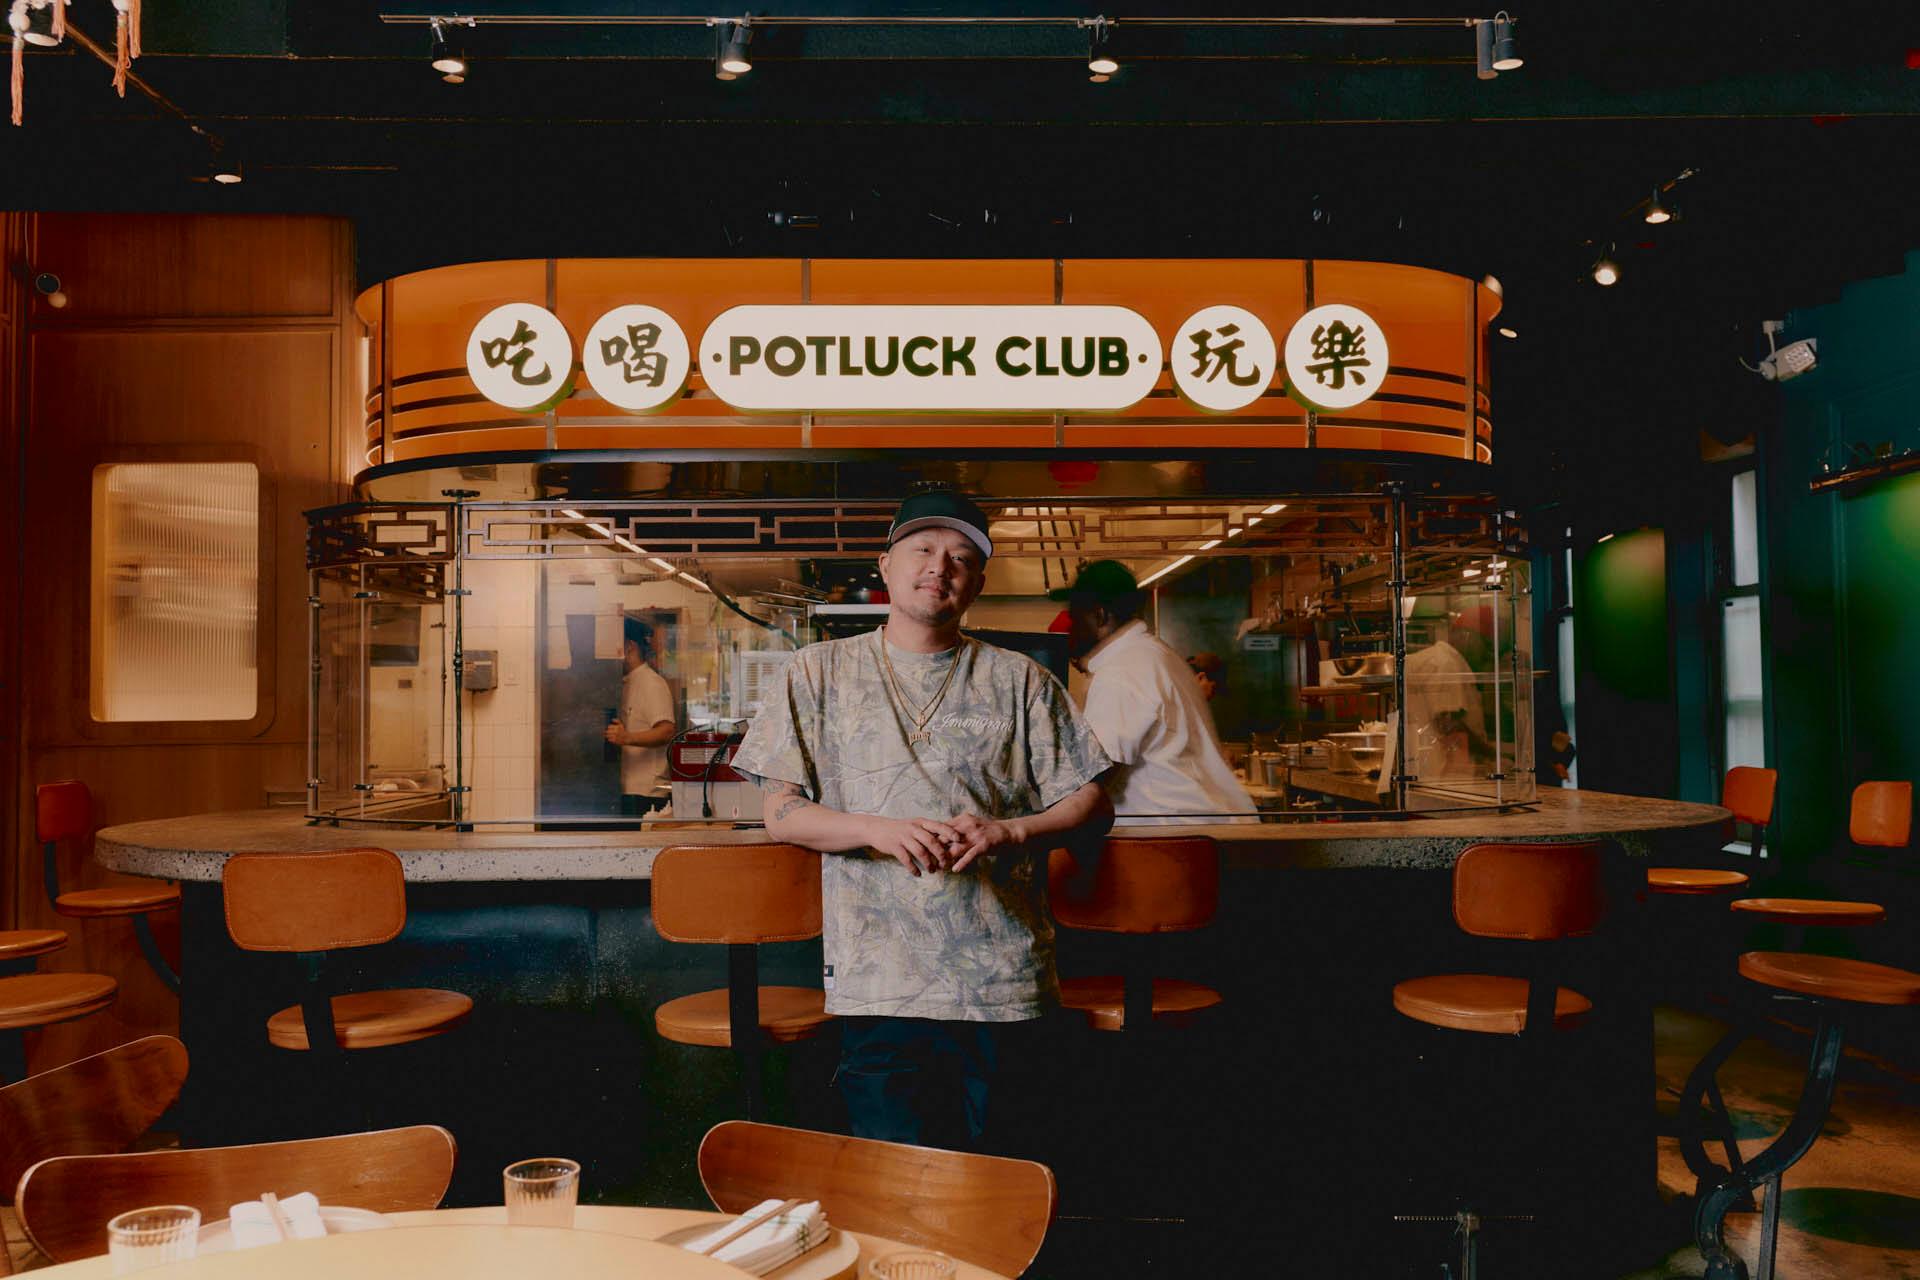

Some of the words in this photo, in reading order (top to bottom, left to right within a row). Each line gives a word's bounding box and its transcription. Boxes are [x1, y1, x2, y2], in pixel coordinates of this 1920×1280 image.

[480, 320, 668, 387] 吃喝
[729, 335, 977, 378] POTLUCK
[995, 335, 1130, 378] CLUB
[1188, 320, 1371, 389] 玩樂
